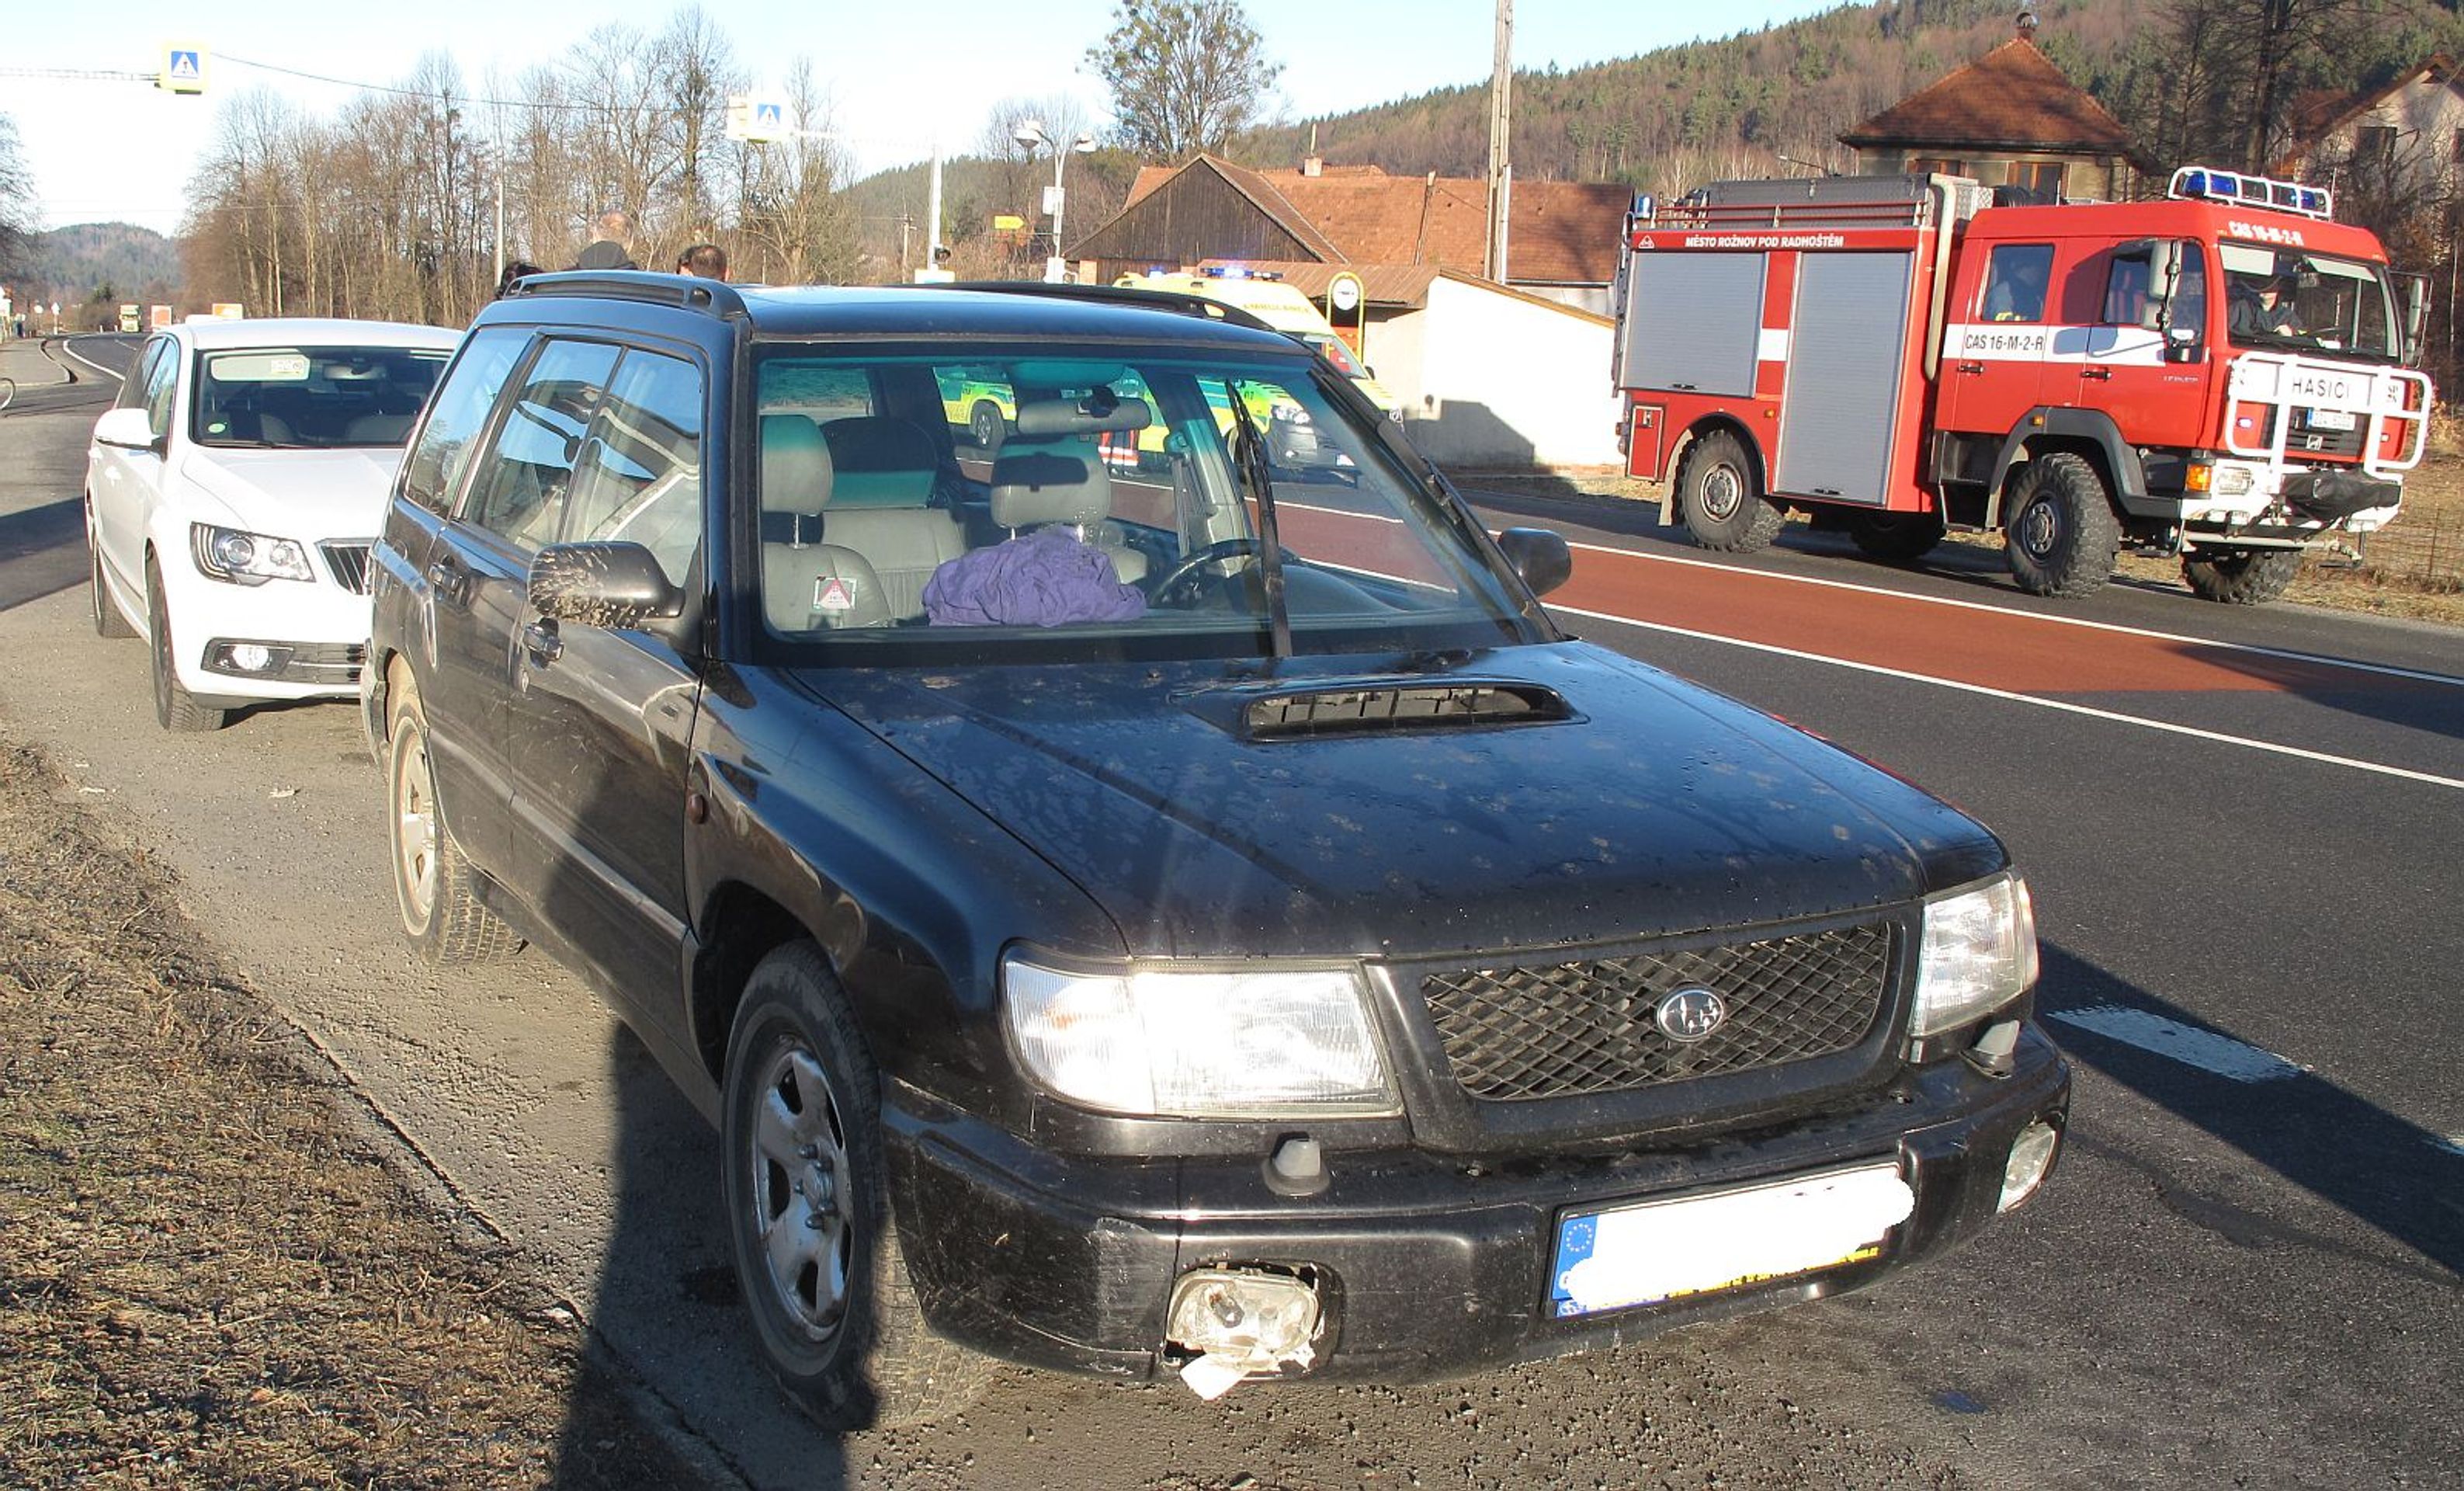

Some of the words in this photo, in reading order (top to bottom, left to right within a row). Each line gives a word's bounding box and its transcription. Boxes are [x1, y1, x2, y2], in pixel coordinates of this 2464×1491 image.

[1685, 235, 1716, 247] MĚSTO
[1717, 235, 1758, 247] ROŽNOV
[1758, 236, 1779, 247] POD
[1966, 334, 1987, 349] CAS
[1990, 335, 2044, 351] 16-M-2-R
